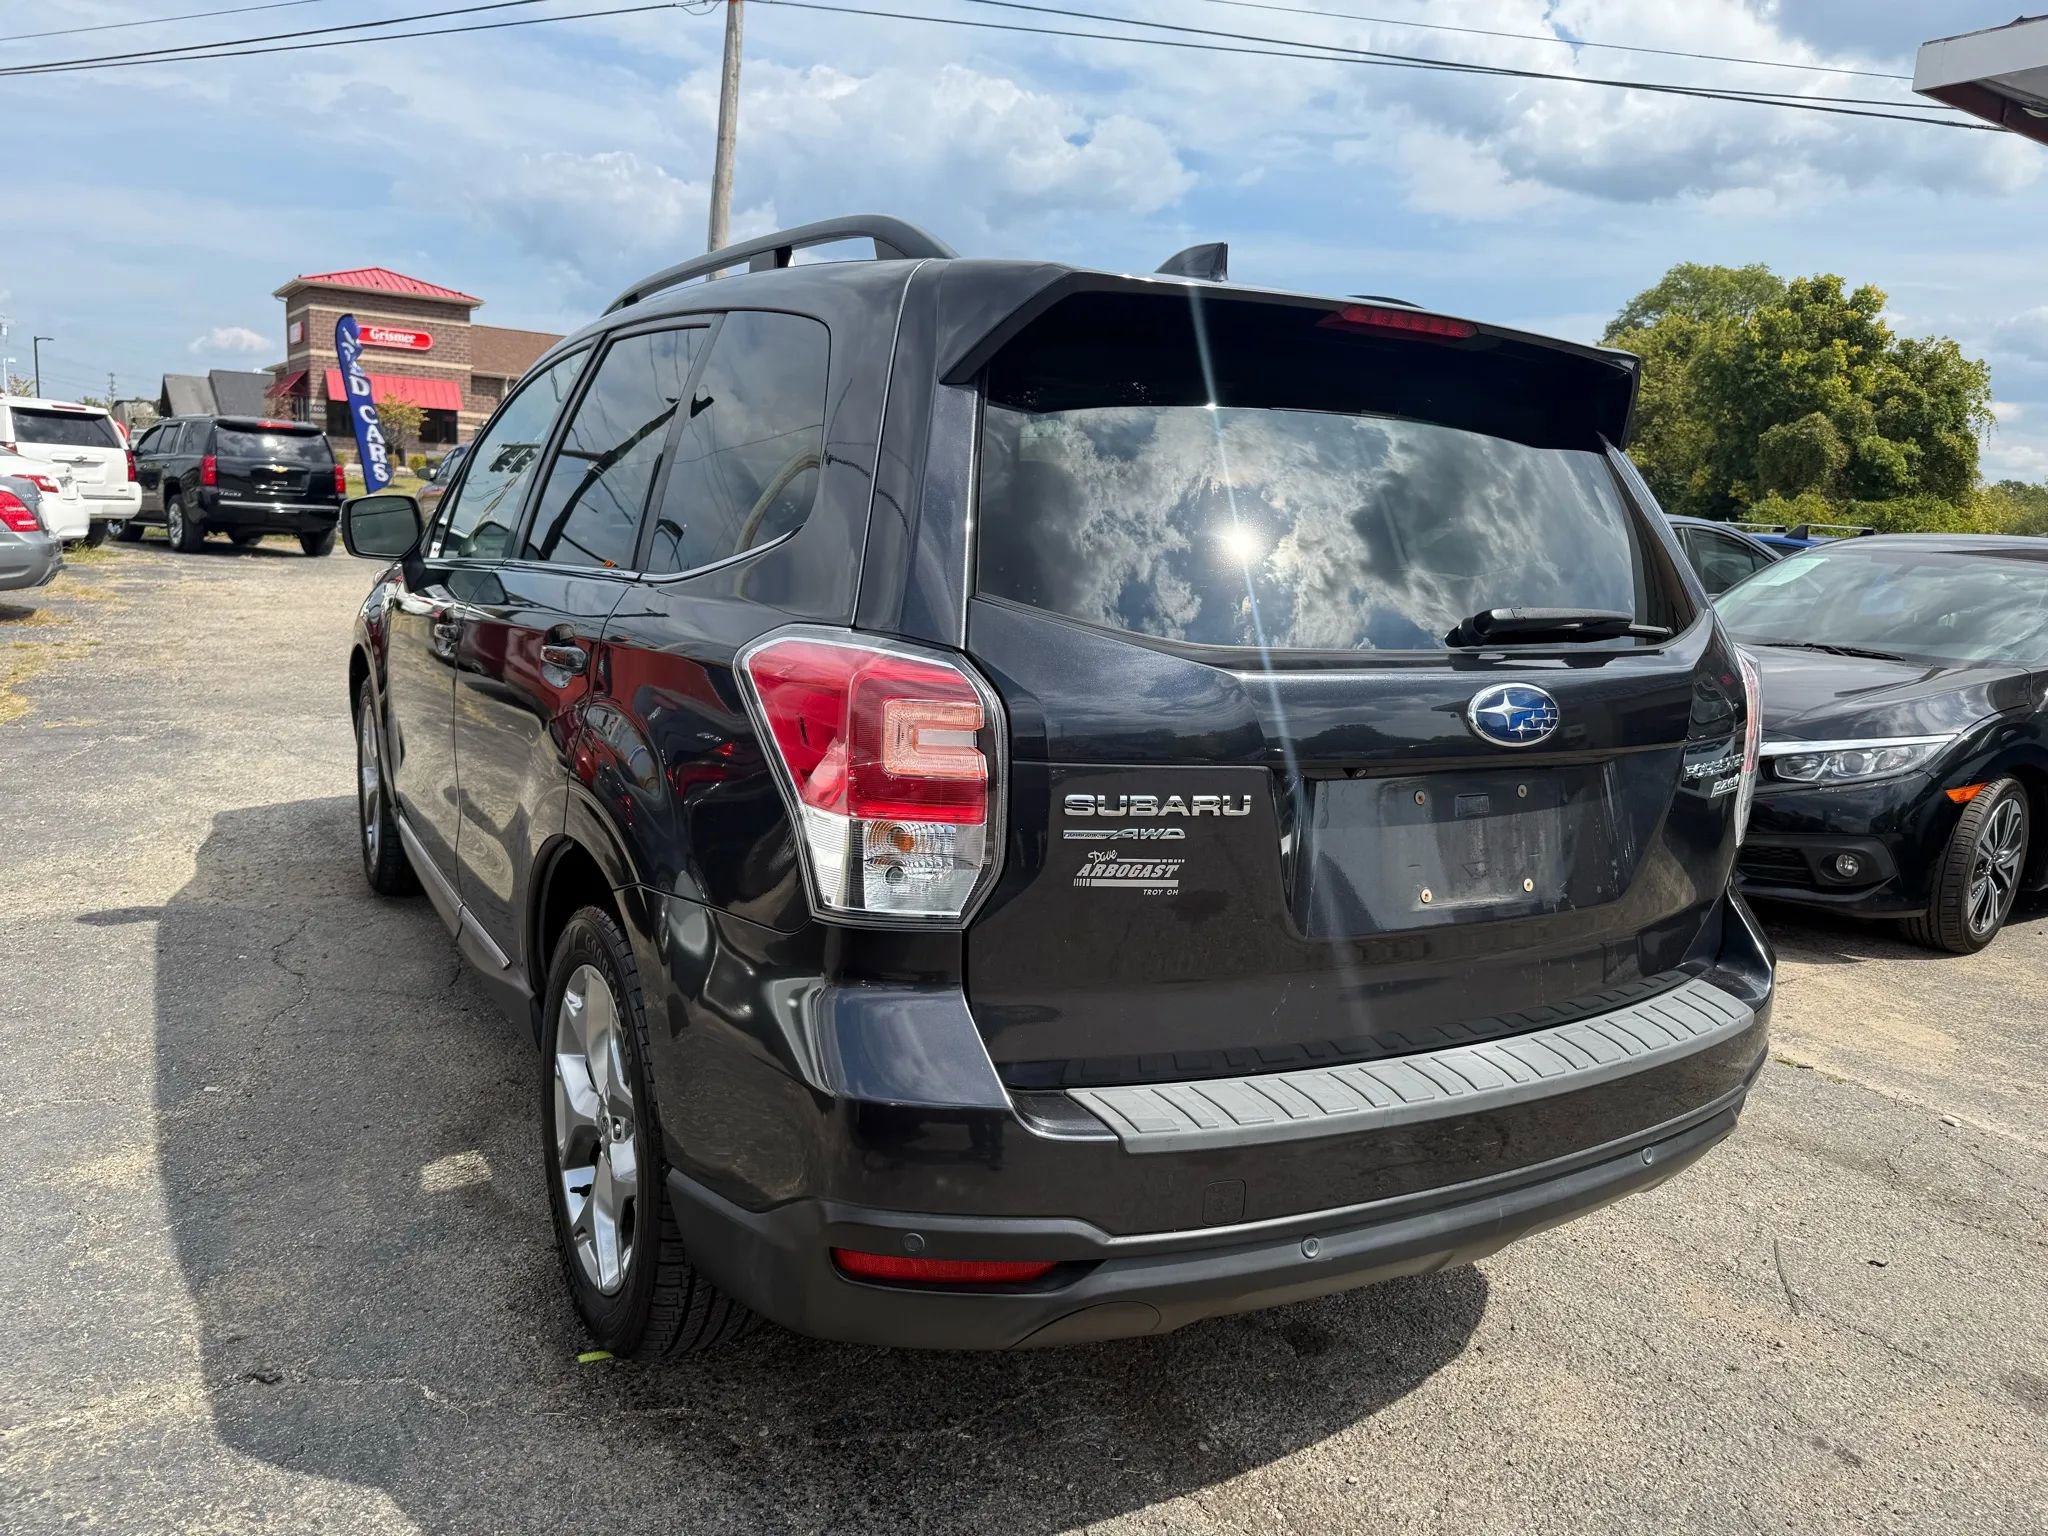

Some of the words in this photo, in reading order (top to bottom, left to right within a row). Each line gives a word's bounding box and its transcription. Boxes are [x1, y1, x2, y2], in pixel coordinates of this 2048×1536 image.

[369, 328, 417, 344] Grismer
[359, 405, 389, 482] CARS
[1063, 794, 1252, 817] SUBARU
[1109, 828, 1186, 840] AWD
[1087, 849, 1118, 866] Dave
[1076, 863, 1180, 878] ARBOGAST
